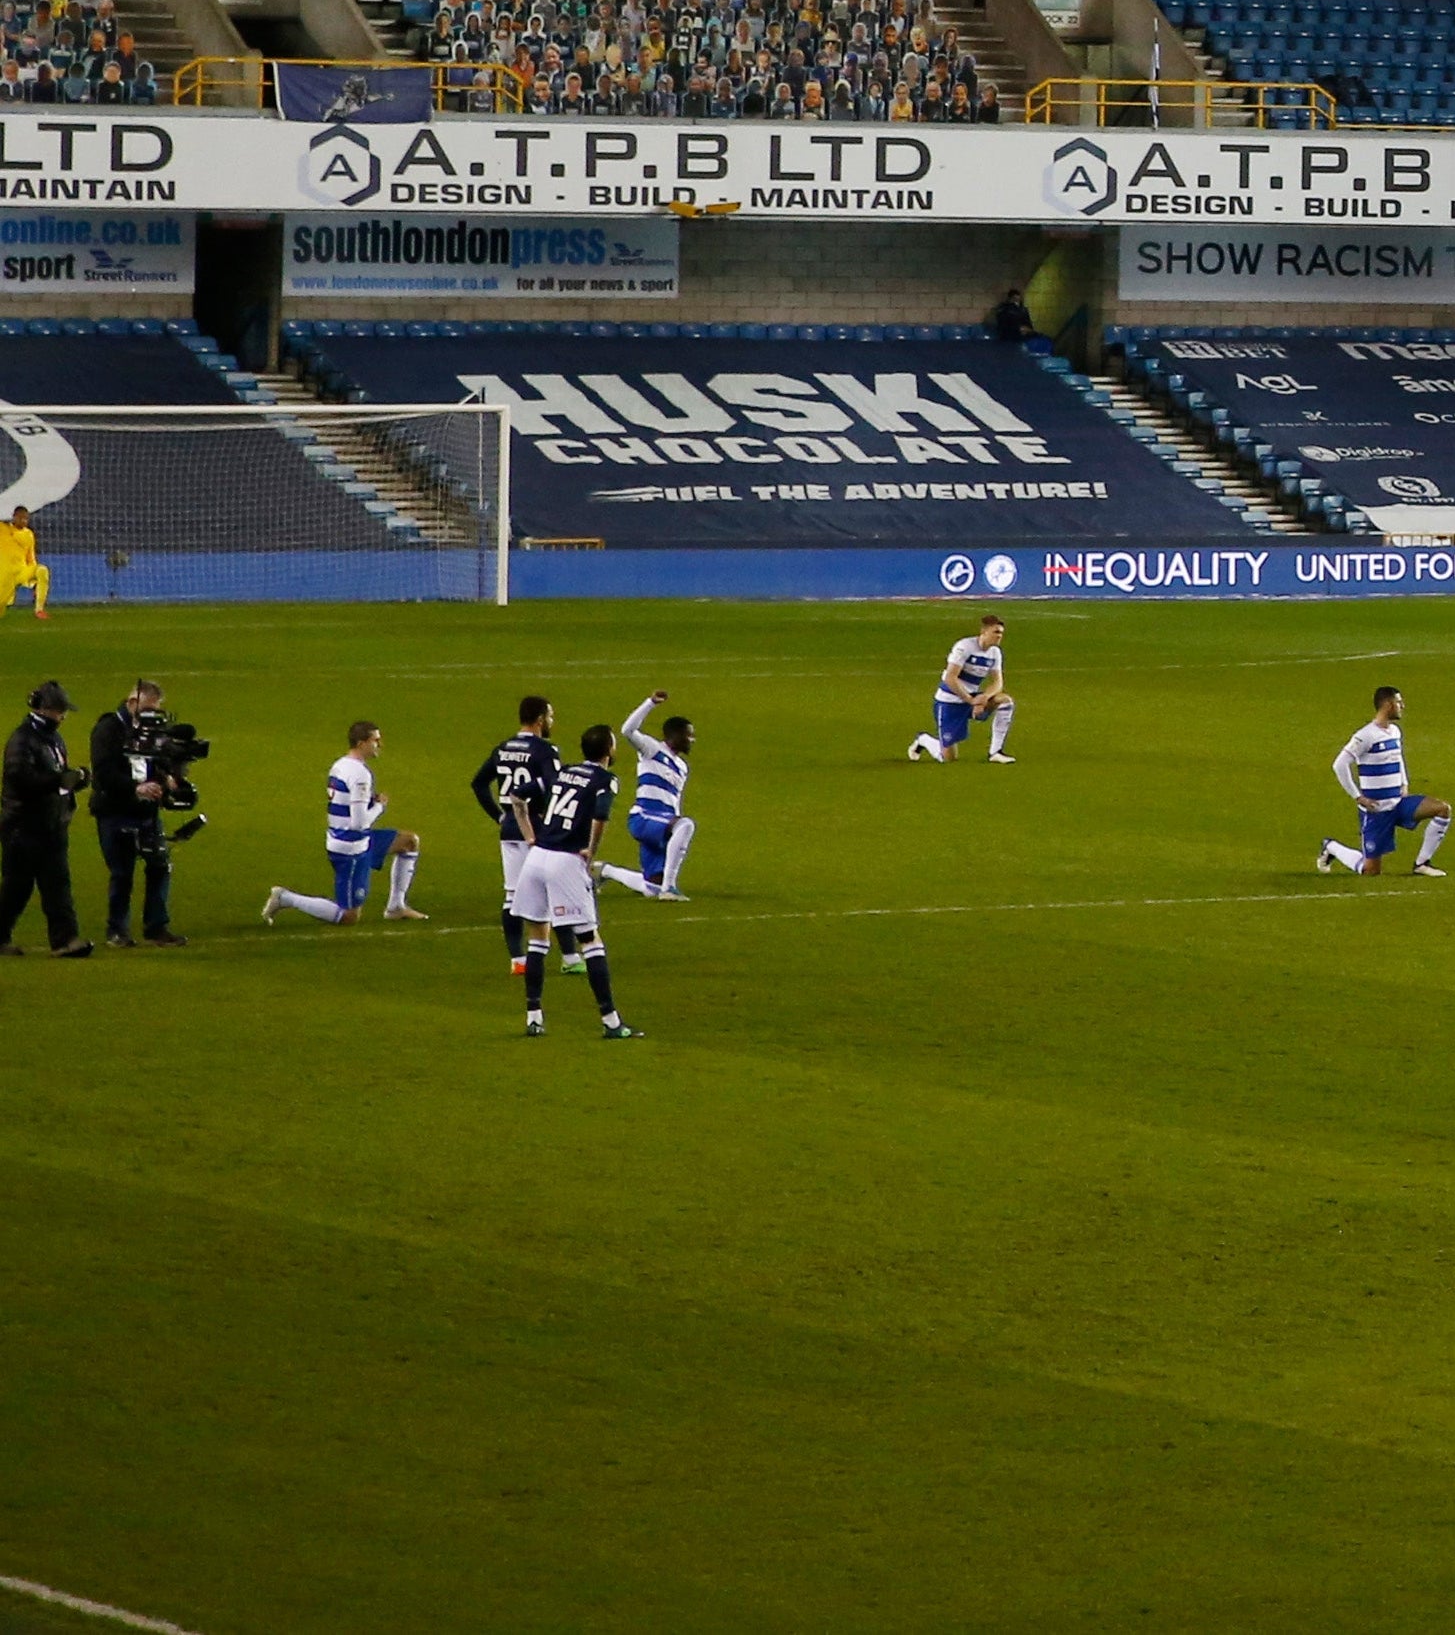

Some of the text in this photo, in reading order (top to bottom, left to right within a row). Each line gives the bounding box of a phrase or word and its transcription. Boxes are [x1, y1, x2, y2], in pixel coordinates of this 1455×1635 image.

[769, 134, 931, 183] LTD
[390, 183, 533, 206] DESIGN
[589, 185, 697, 207] BUILD
[750, 187, 934, 211] MAINTAIN
[1124, 193, 1254, 215] DESIGN
[1304, 197, 1402, 218] BUILD
[293, 220, 607, 268] southlondonpress
[1137, 241, 1263, 277] SHOW
[1275, 243, 1434, 279] RACISM
[3, 252, 75, 283] sport
[516, 278, 535, 291] for
[538, 278, 554, 291] all
[558, 281, 586, 294] your
[590, 281, 625, 292] news
[640, 278, 674, 294] sport
[456, 372, 1034, 435] HUSKI
[532, 436, 1072, 465] CHOCOLATE
[750, 483, 832, 502] THE
[844, 482, 1109, 501] ADVENTURE!
[1044, 551, 1269, 592] INEQUALITY
[1296, 553, 1407, 582] UNITED
[543, 784, 580, 830] 14
